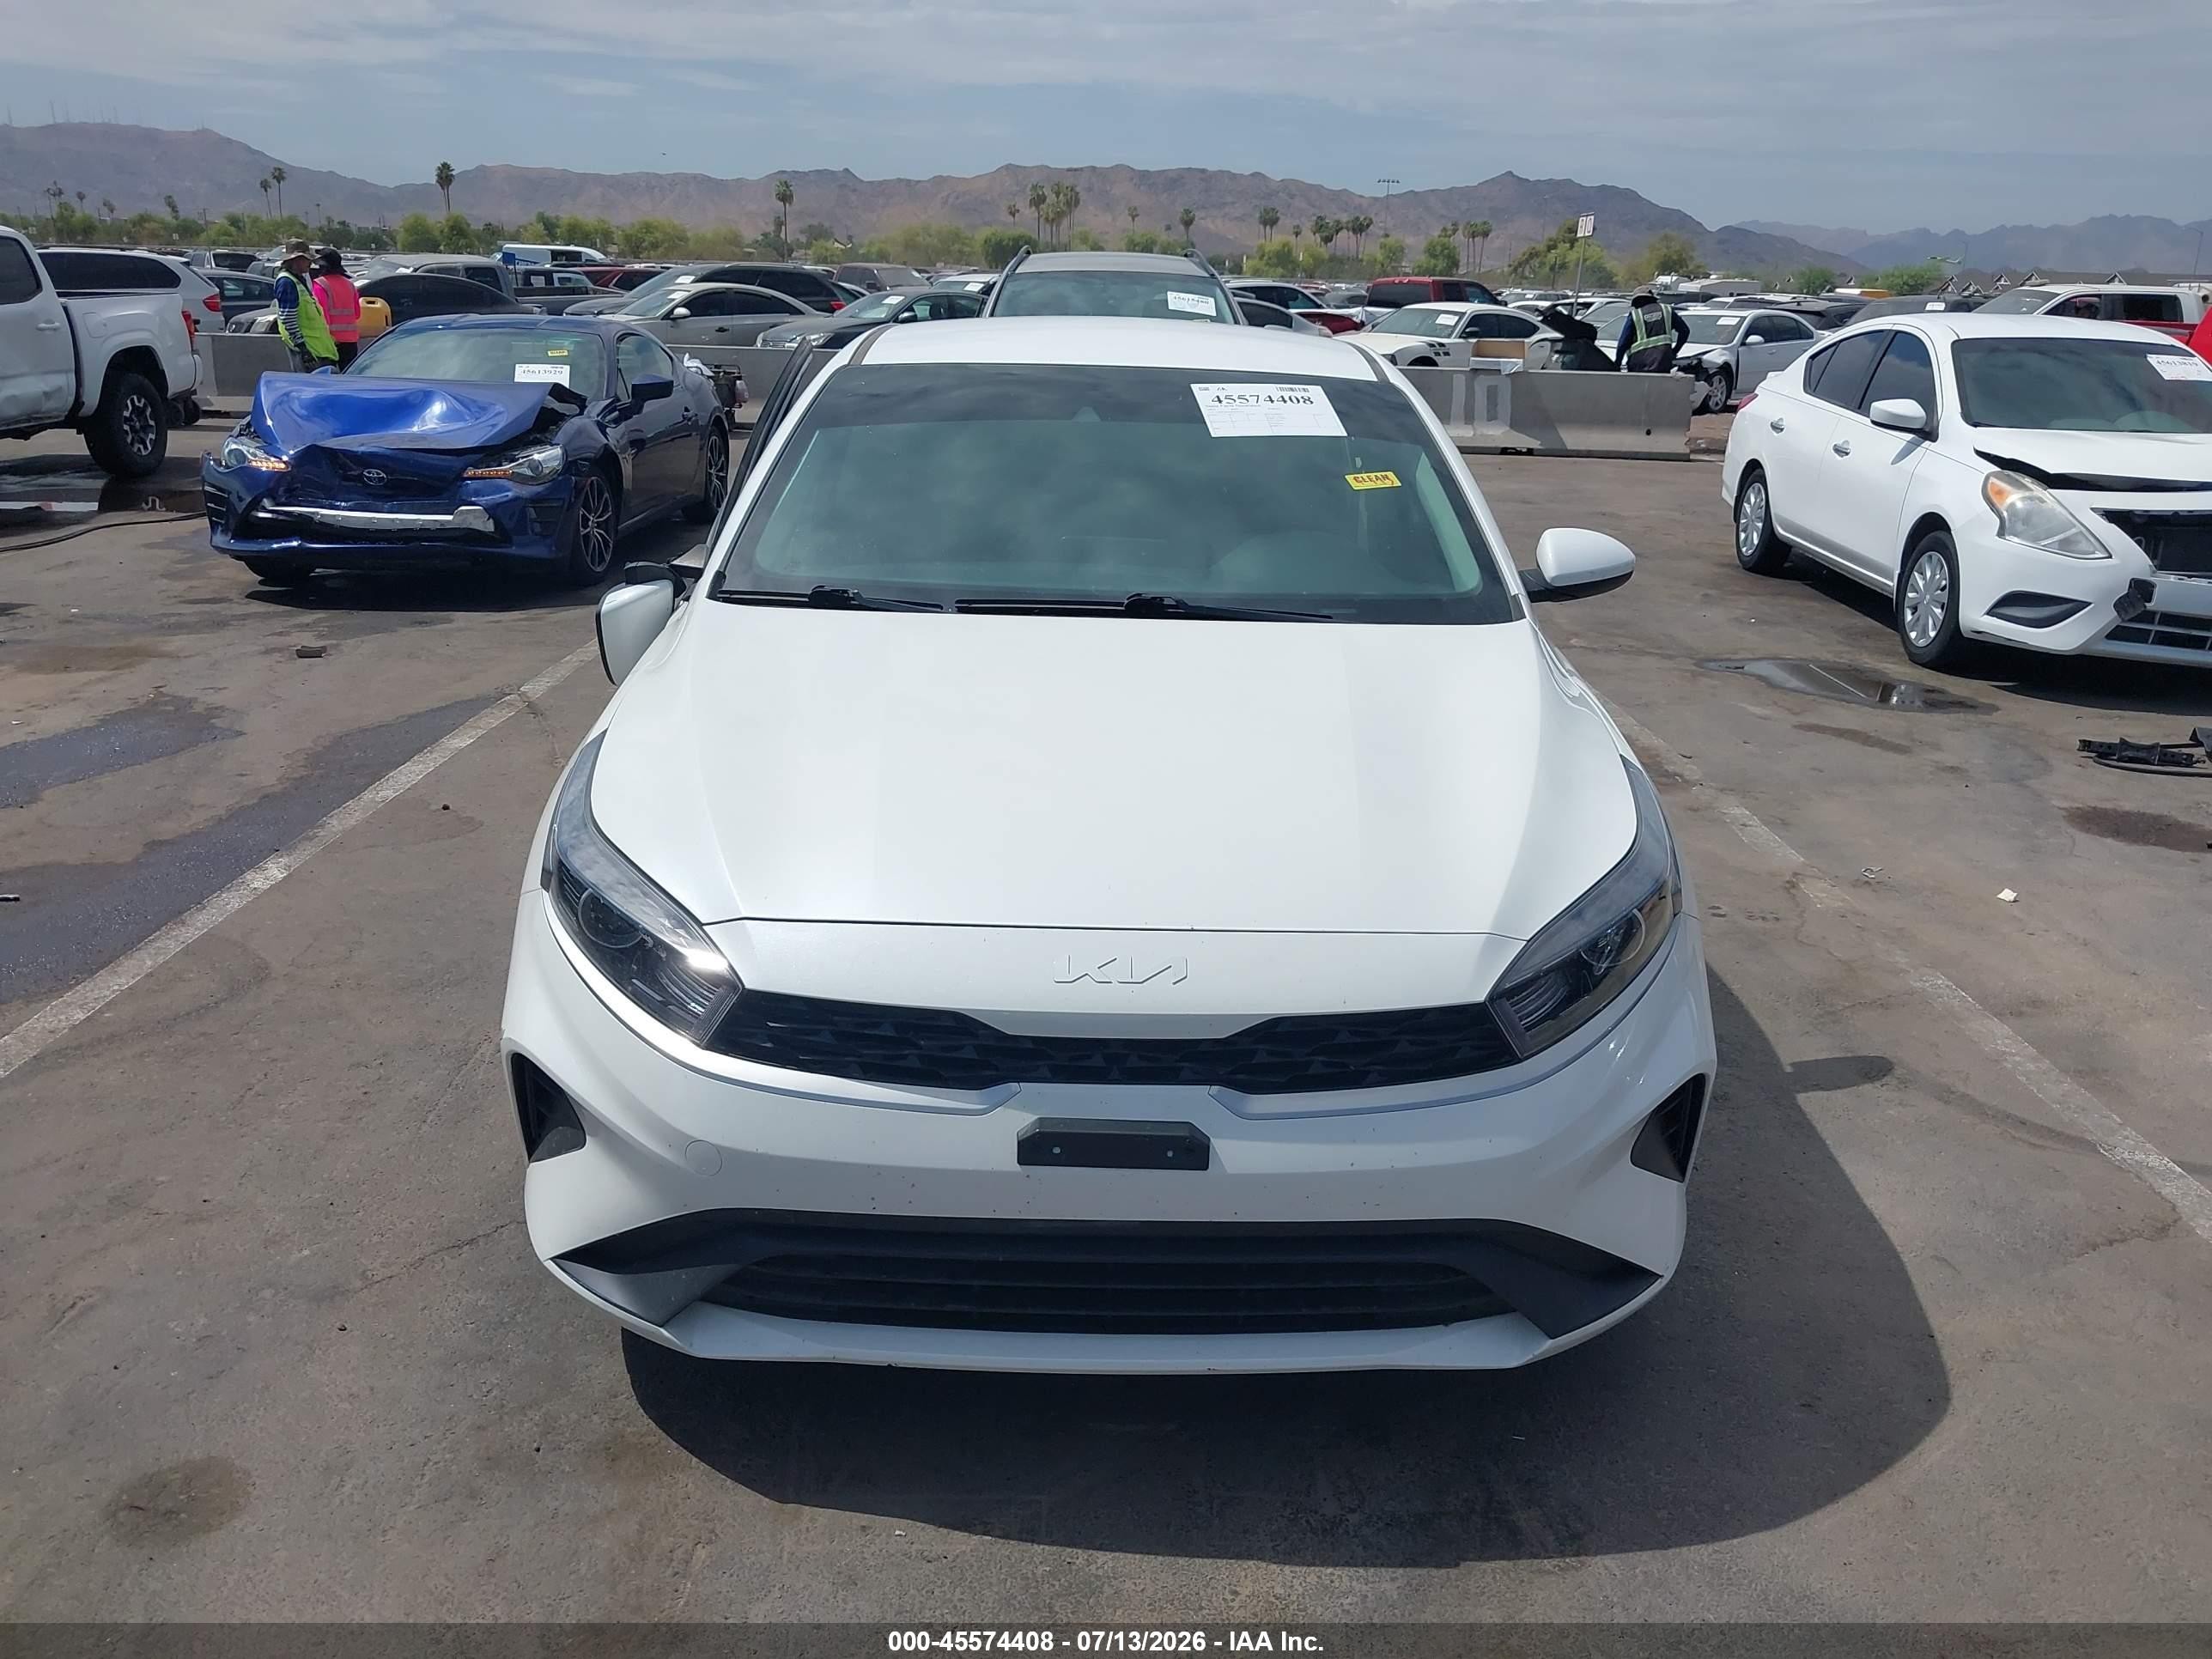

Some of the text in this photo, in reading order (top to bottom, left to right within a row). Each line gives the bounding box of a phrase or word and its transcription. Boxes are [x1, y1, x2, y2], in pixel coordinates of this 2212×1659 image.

[1211, 394, 1314, 405] 45574408
[1352, 474, 1390, 483] CLEAN
[1054, 954, 1188, 985] KIA
